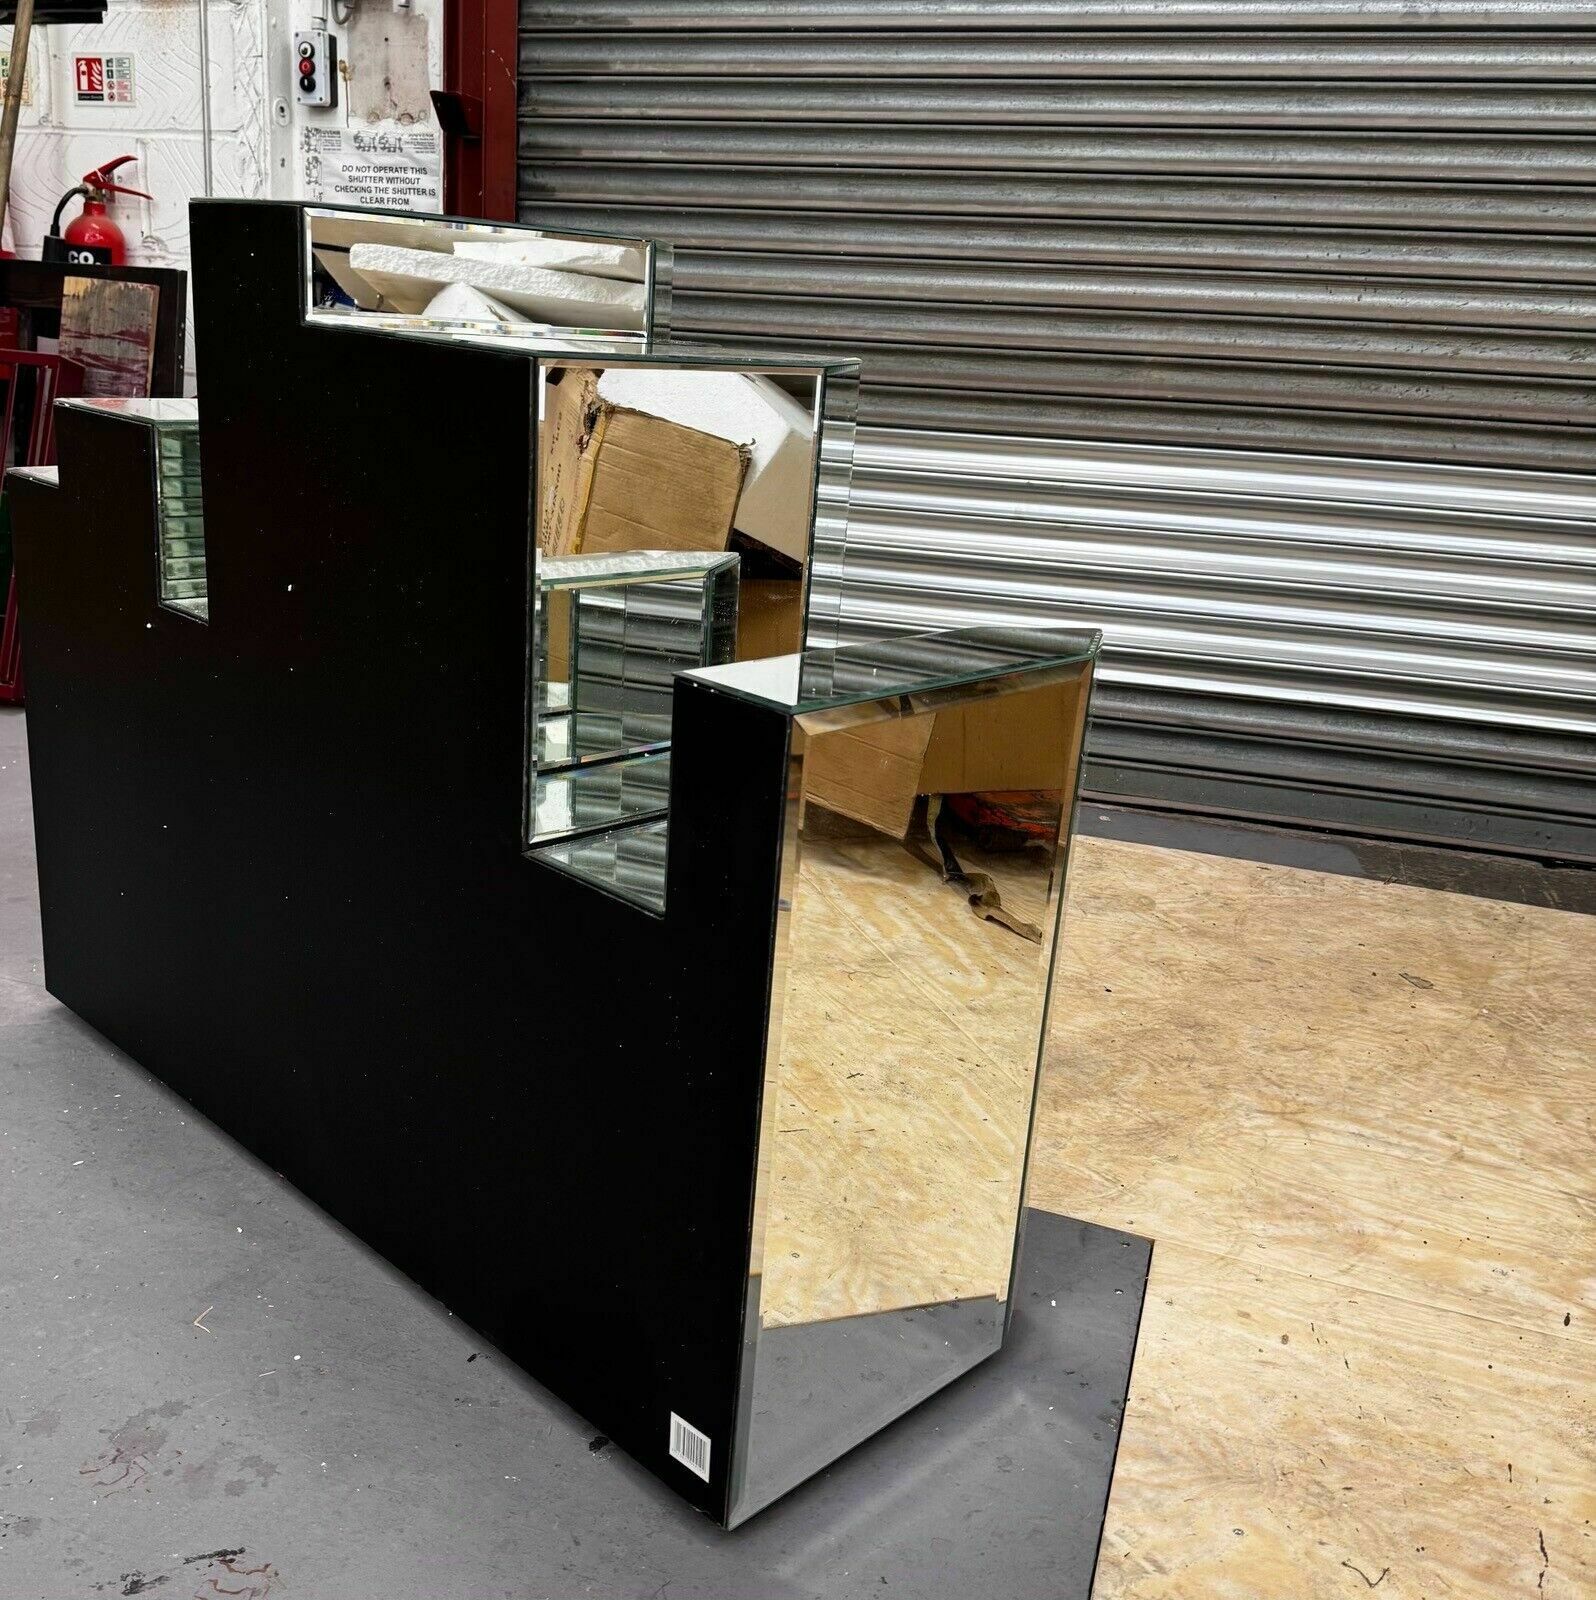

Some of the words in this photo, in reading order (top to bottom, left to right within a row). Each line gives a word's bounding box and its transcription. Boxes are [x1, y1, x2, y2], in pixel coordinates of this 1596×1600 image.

[342, 164, 353, 172] DO
[356, 165, 371, 174] NOT
[372, 166, 408, 174] OPERATE
[410, 167, 428, 175] THIS
[348, 175, 384, 184] SHUTTER
[386, 176, 420, 185] WITHOUT
[334, 185, 372, 194] CHECKING
[374, 186, 389, 194] THE
[392, 188, 429, 196] SHUTTER
[429, 188, 436, 196] IS
[360, 196, 385, 204] CLEAR
[387, 197, 410, 206] FROM
